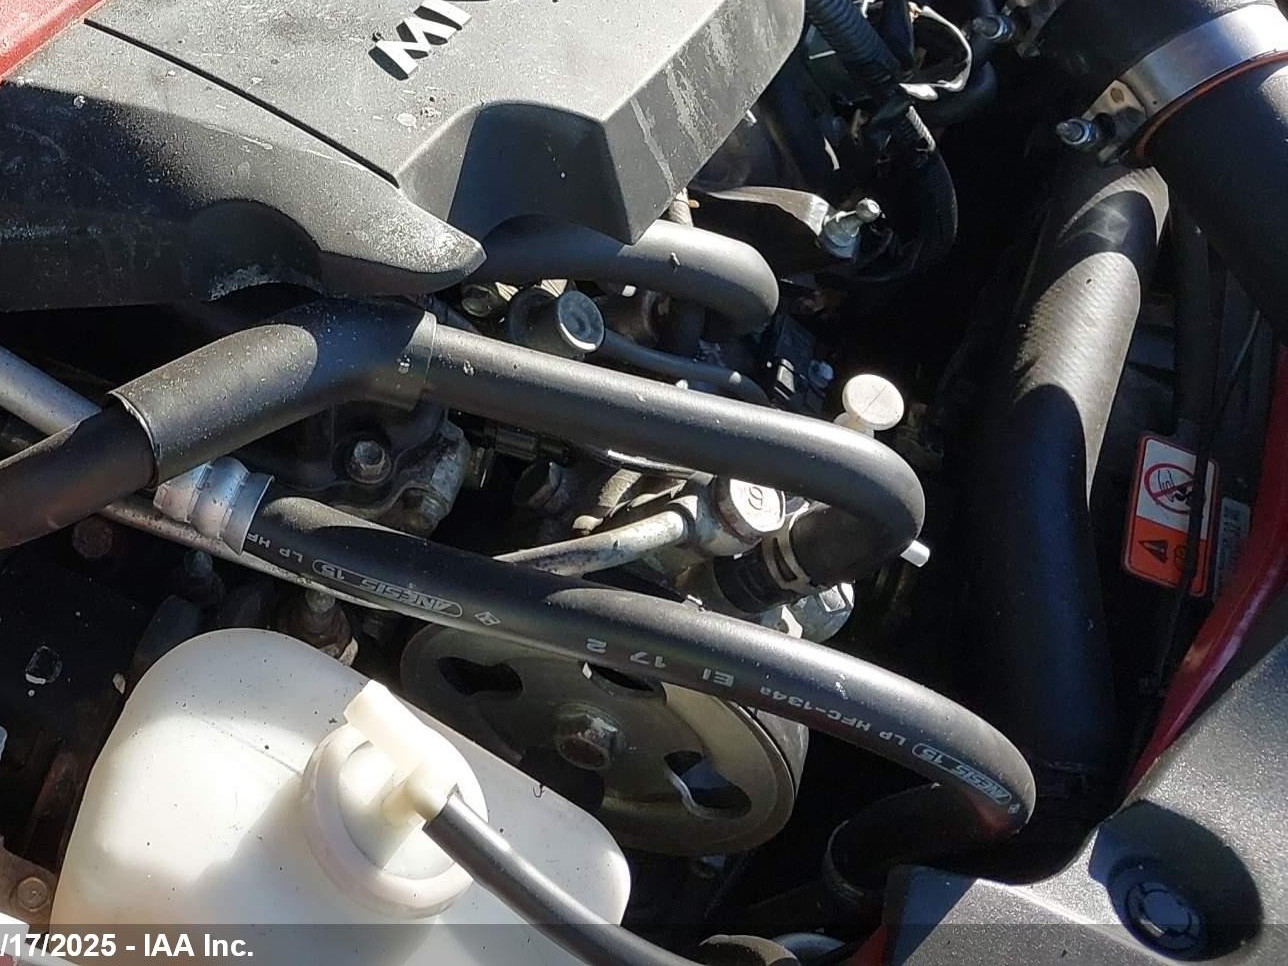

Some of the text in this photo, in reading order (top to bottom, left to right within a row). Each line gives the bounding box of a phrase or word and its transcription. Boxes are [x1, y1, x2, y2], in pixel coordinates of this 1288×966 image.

[279, 547, 304, 563] LP
[321, 564, 345, 581] 15
[585, 637, 608, 654] 2
[629, 650, 666, 669] 17
[759, 686, 872, 732] HFC-134a
[879, 730, 906, 746] LP
[921, 748, 943, 764] 15
